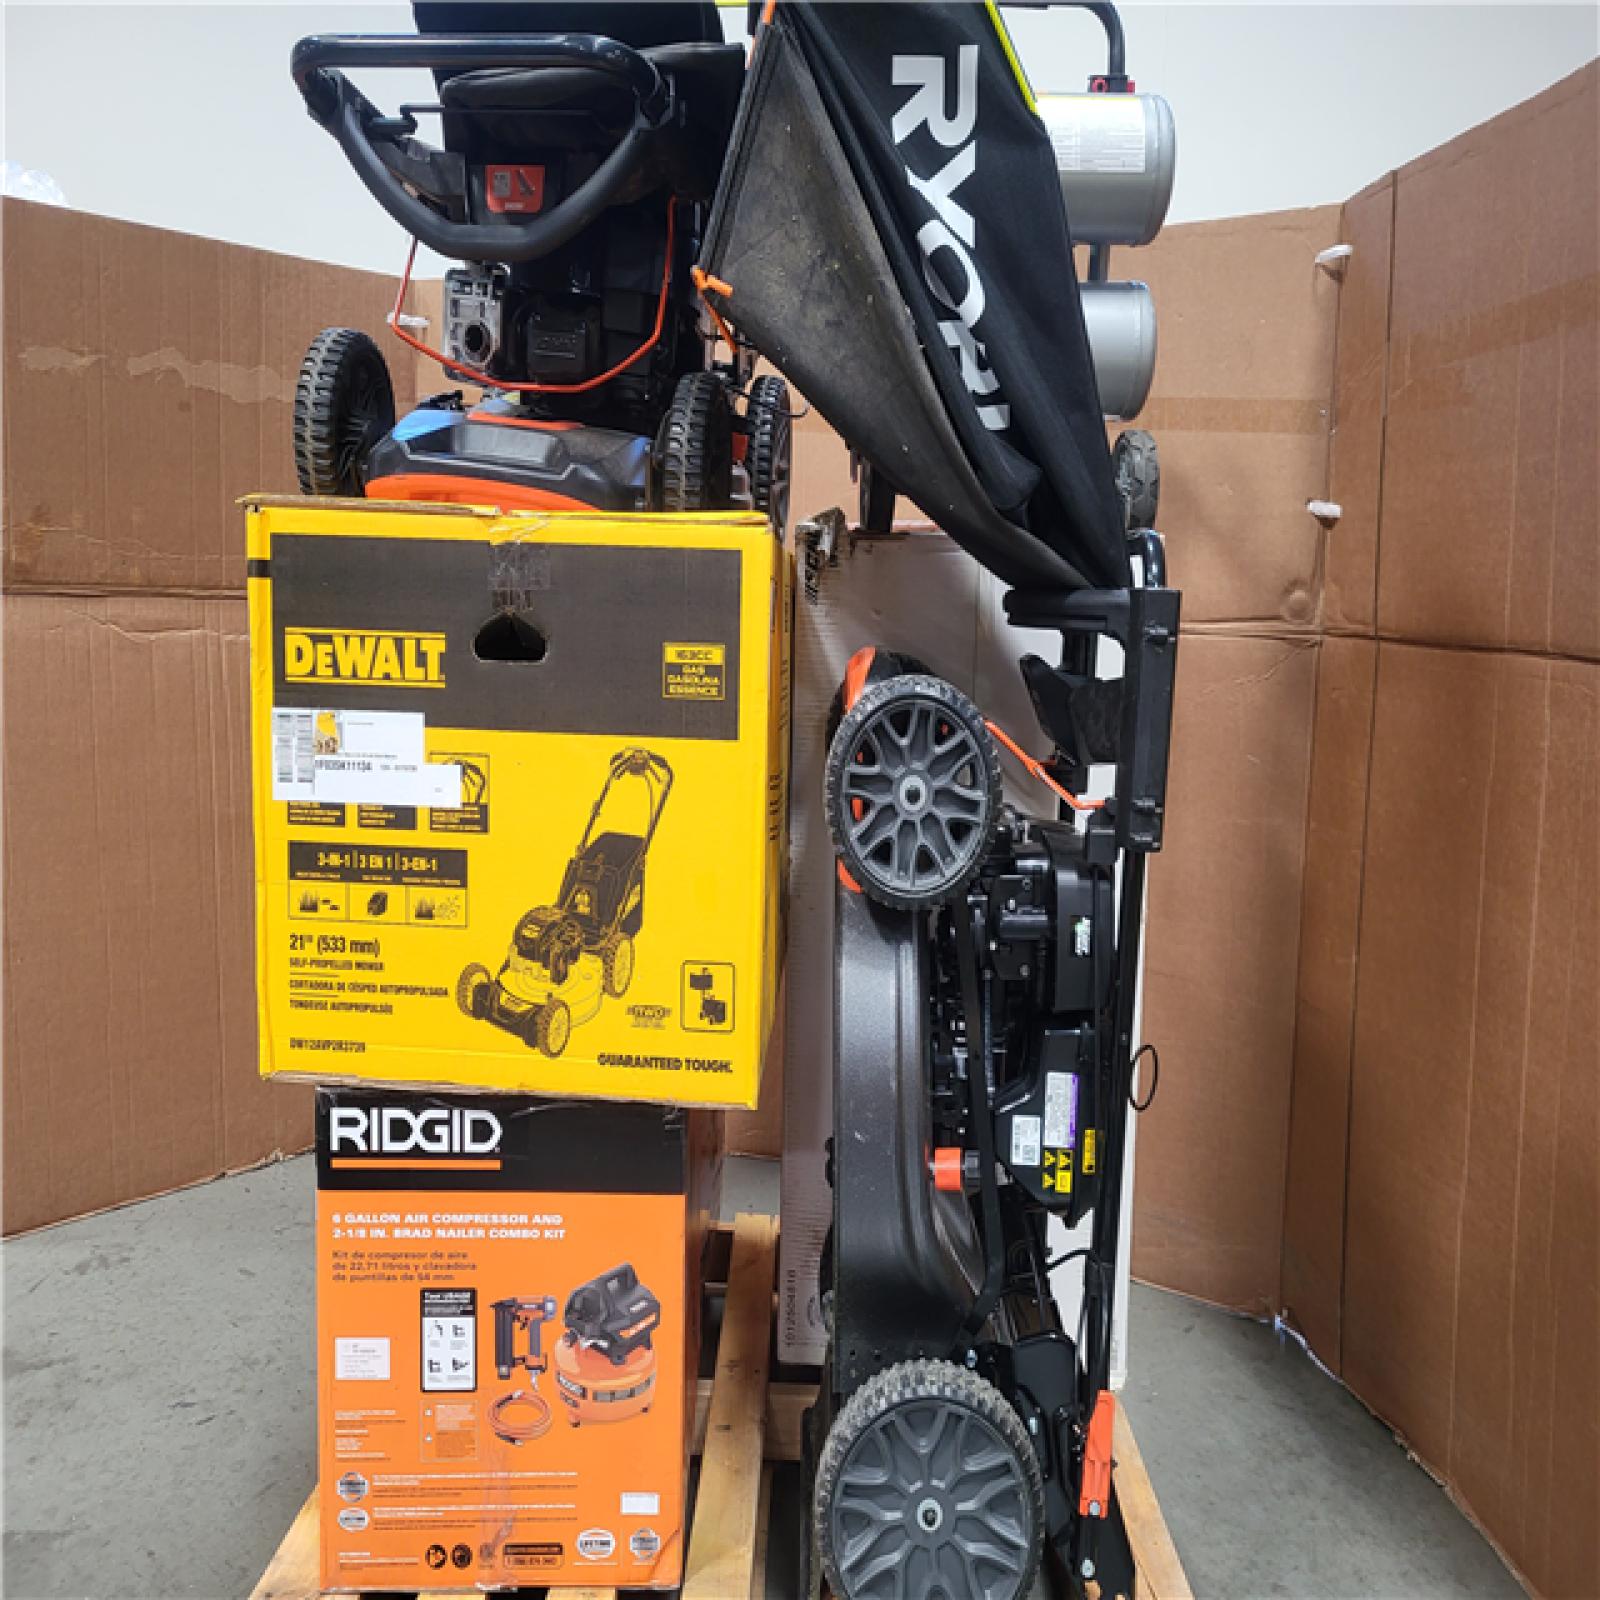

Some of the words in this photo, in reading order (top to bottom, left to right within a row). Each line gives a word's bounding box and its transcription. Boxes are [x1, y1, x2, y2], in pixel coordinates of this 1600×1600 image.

[316, 934, 346, 955] (533
[349, 938, 380, 958] mm)
[597, 1053, 681, 1070] GUARANTEED
[330, 1107, 502, 1153] RIDGID
[344, 1213, 400, 1224] GALLON
[404, 1213, 429, 1224] AIR
[432, 1213, 528, 1225] COMPRESSOR
[531, 1214, 564, 1226] AND
[392, 1228, 433, 1239] BRAD
[435, 1228, 486, 1239] NAILER
[489, 1229, 541, 1240] COMBO
[544, 1229, 567, 1239] KIT
